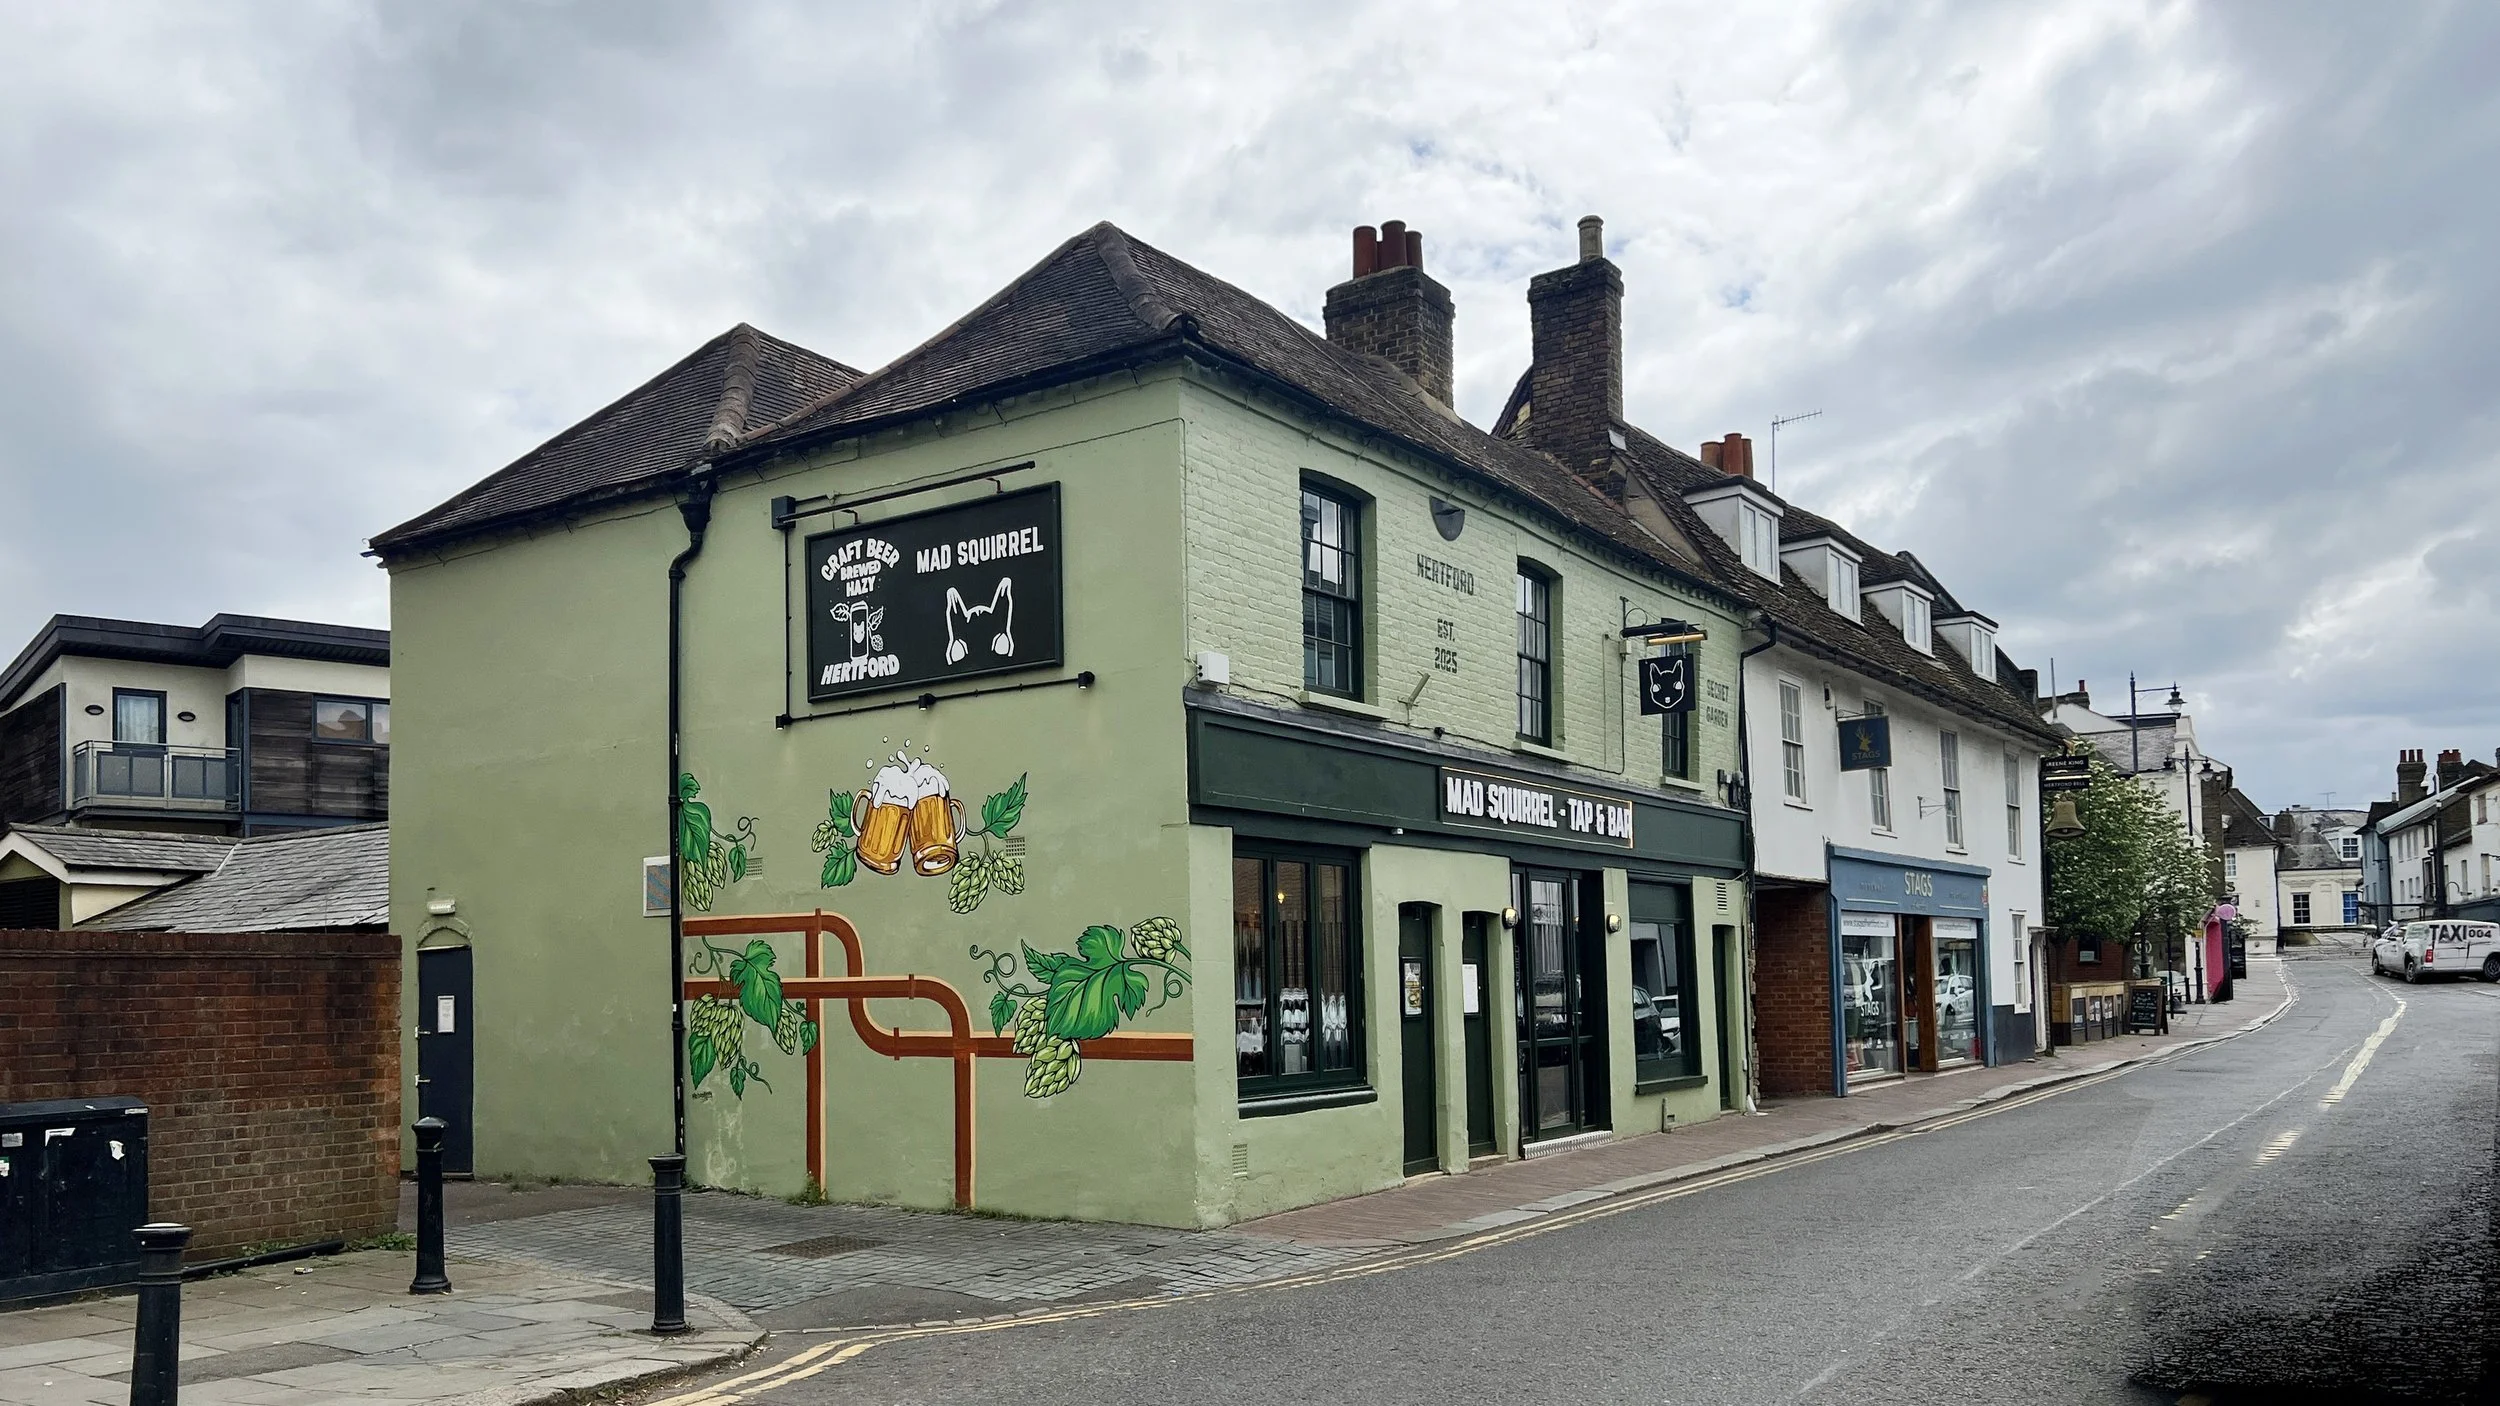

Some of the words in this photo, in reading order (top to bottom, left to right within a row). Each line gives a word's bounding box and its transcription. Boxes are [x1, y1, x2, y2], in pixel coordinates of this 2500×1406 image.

[821, 539, 863, 581] CRAFT
[866, 538, 900, 568] BEER
[916, 544, 952, 574] MAD
[957, 526, 1044, 566] SQUIRREL
[840, 560, 881, 581] BREWED
[1417, 553, 1474, 596] HERTFORD
[846, 575, 876, 597] HAZY
[1437, 618, 1455, 642] EST.
[820, 654, 900, 686] HERTFORD
[1434, 646, 1457, 674] 2025
[1852, 750, 1881, 761] STAGS
[1446, 776, 1484, 817] MAD
[1487, 783, 1558, 828] SQUIRREL
[1567, 798, 1594, 833] TAP
[1595, 803, 1605, 835] &
[1607, 805, 1633, 839] BAR
[1904, 871, 1933, 897] STAGS
[2429, 924, 2468, 942] TAXI
[2468, 929, 2492, 939] 004
[1861, 1001, 1880, 1017] STAGS
